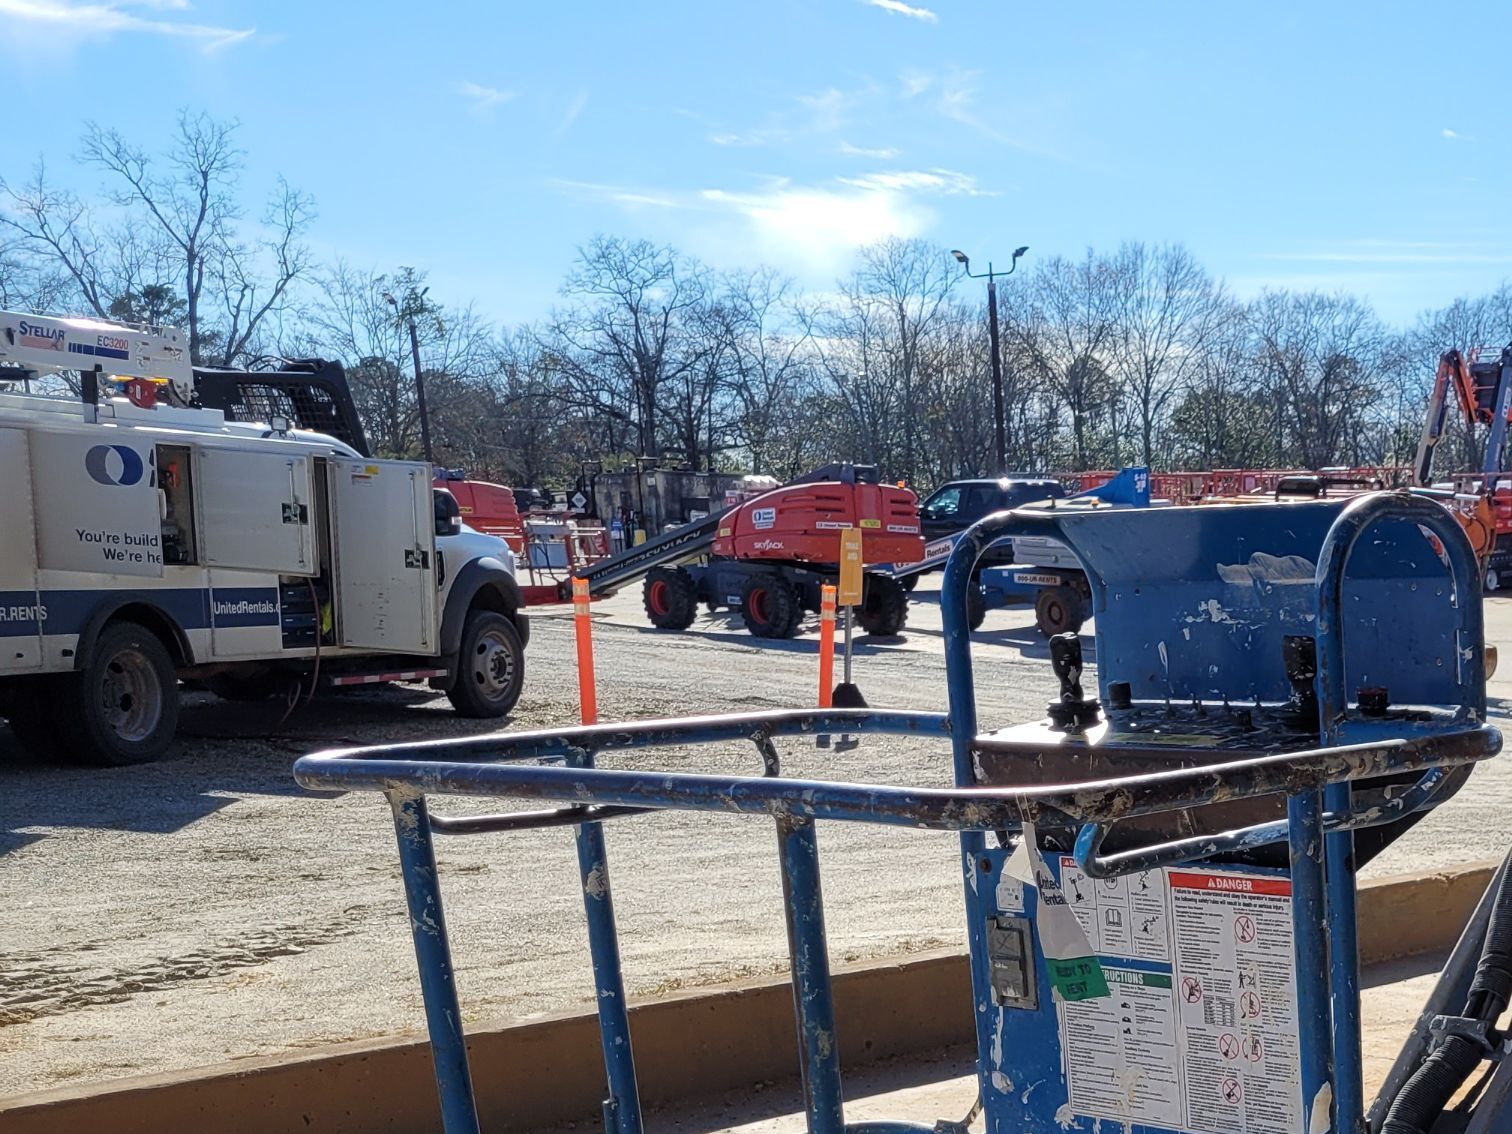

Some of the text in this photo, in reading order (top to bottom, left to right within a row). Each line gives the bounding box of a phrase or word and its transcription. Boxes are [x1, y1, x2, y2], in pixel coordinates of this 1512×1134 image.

[19, 320, 65, 341] STELLAR
[97, 335, 129, 350] EC3200
[75, 528, 120, 544] You're
[103, 547, 143, 561] We're
[1216, 878, 1253, 891] DANGER
[1101, 969, 1144, 985] RUCTIONS
